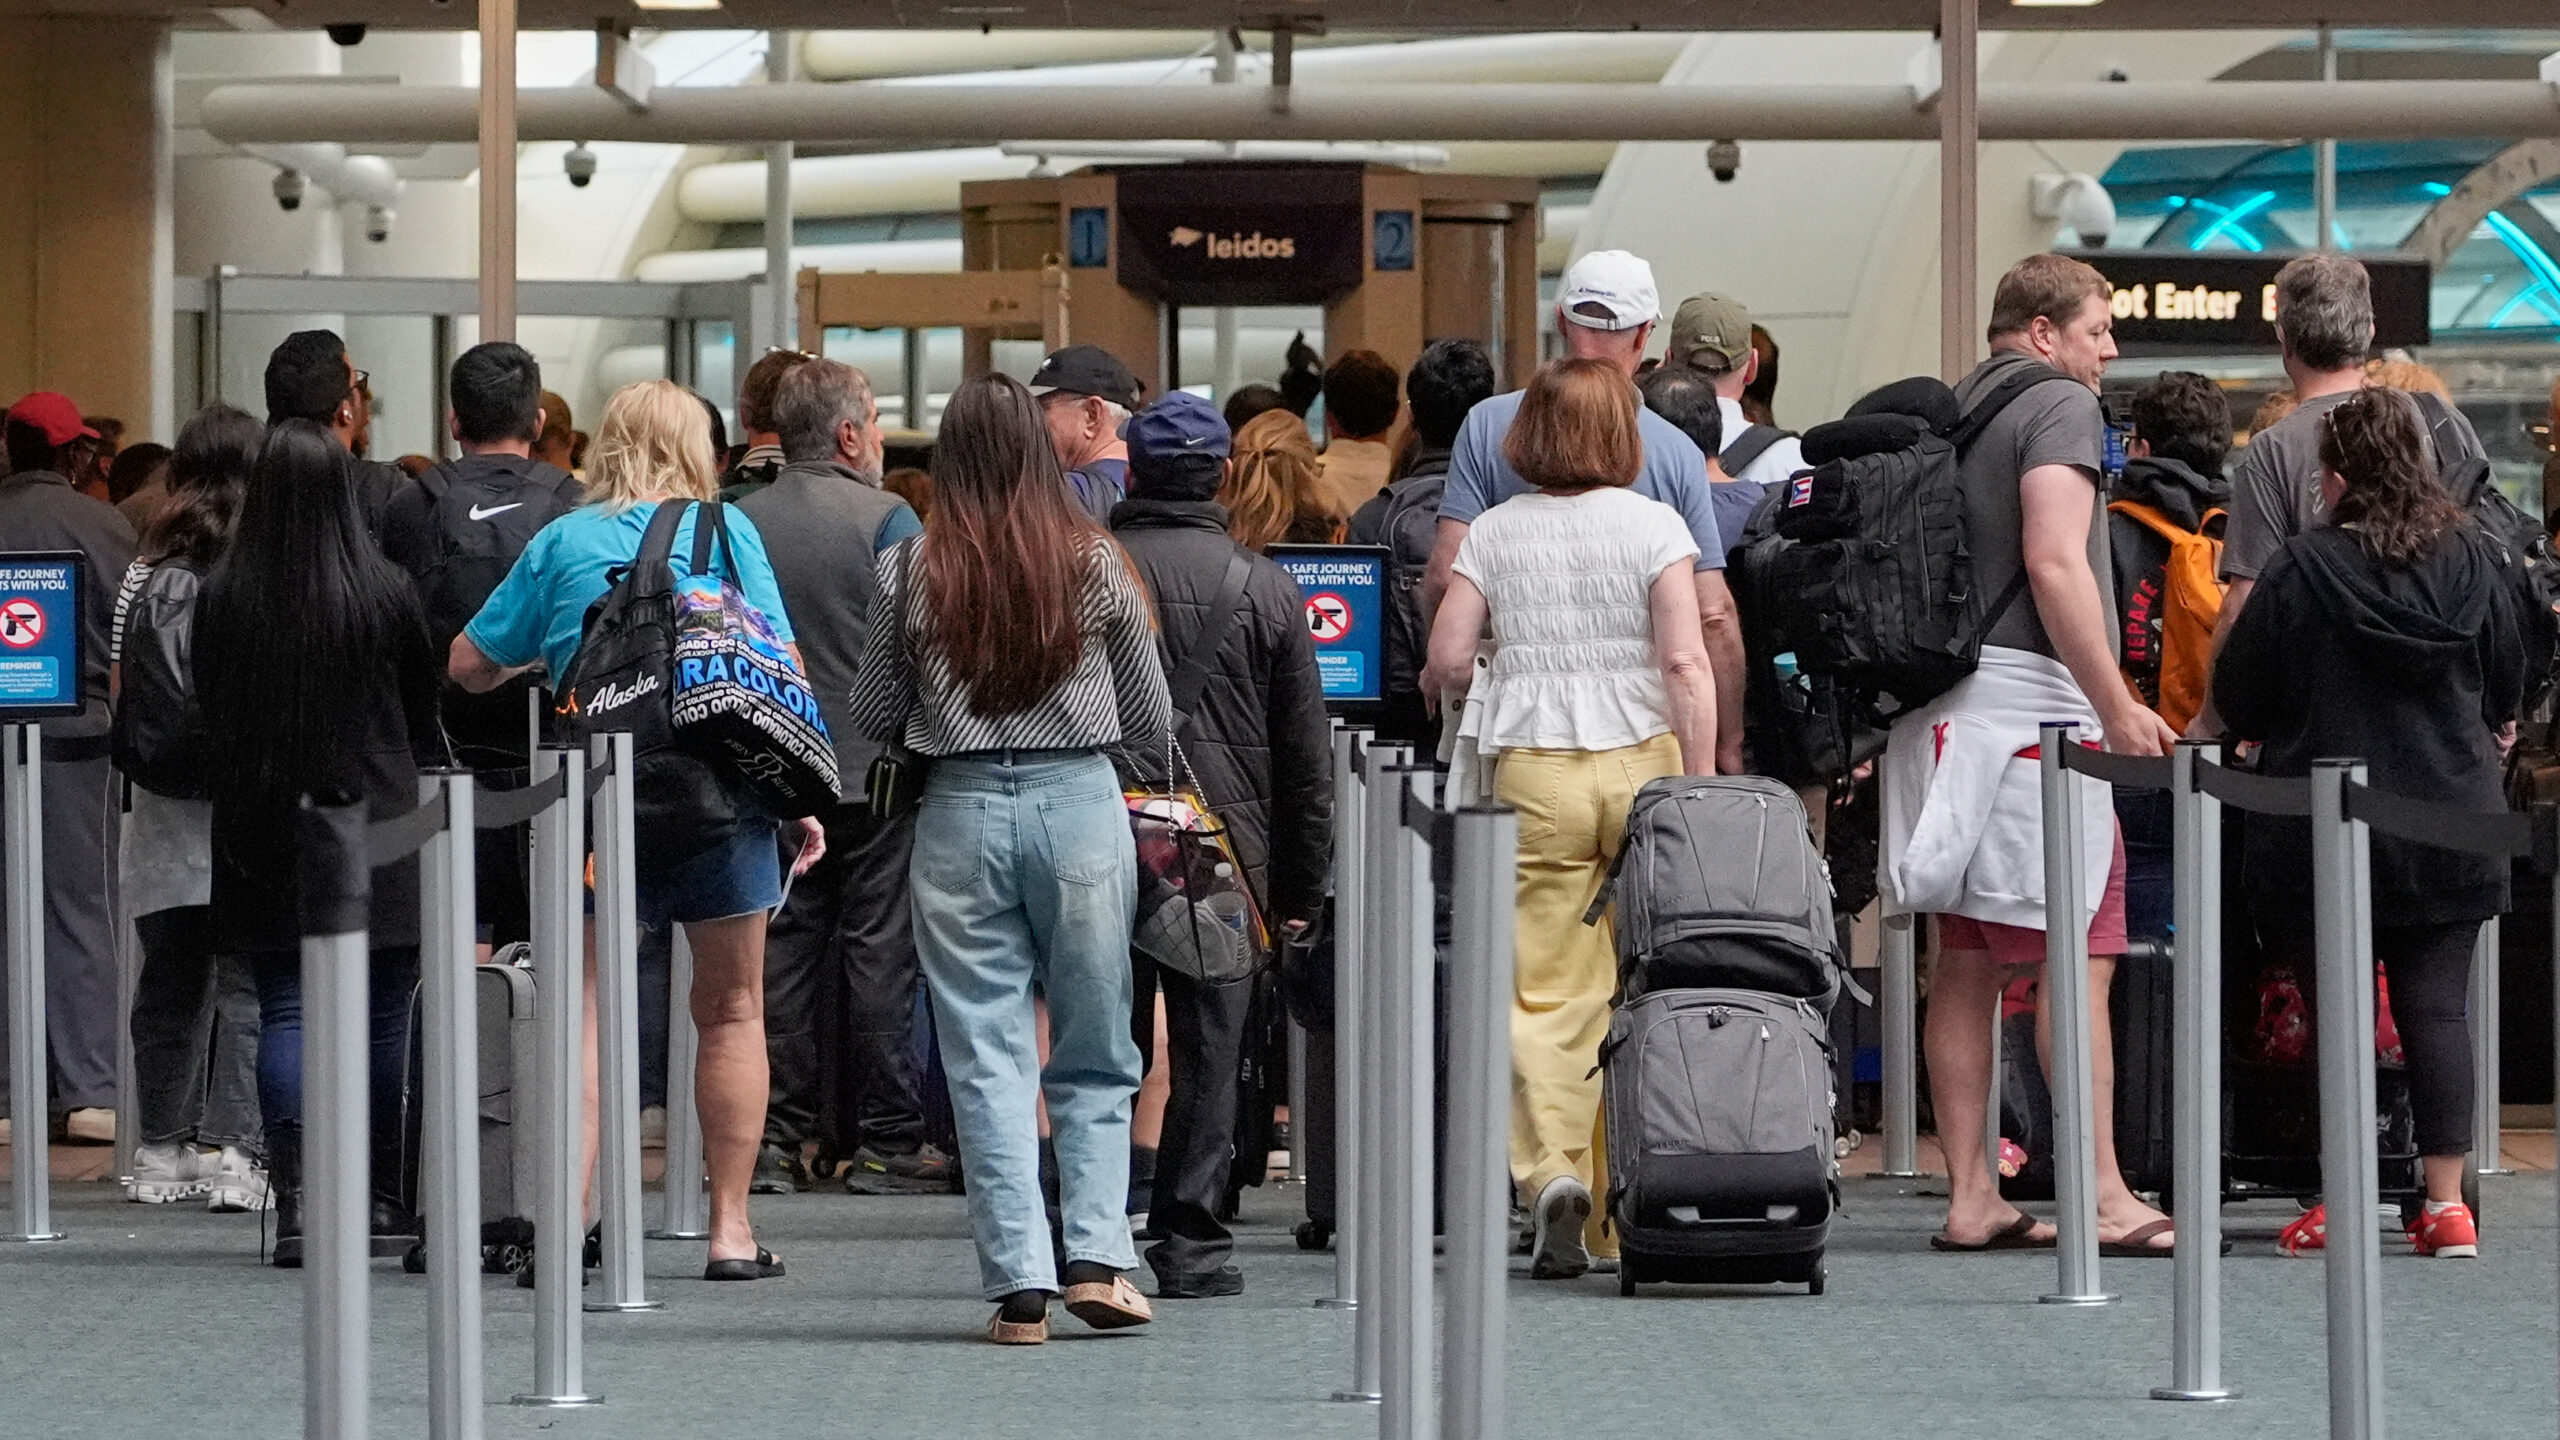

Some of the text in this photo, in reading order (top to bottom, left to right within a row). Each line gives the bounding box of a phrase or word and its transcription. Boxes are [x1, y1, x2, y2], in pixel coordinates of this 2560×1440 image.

[1207, 232, 1295, 259] leidos
[2106, 281, 2148, 319] ot
[2155, 282, 2242, 320] Enter
[1700, 335, 1720, 343] POLO
[13, 569, 65, 579] JOURNEY
[1292, 564, 1319, 574] SAFE
[1320, 564, 1372, 574] JOURNEY
[11, 581, 39, 590] WITH
[41, 580, 69, 590] YOU.
[1317, 575, 1347, 585] WITH
[1349, 575, 1375, 585] YOU.
[0, 662, 43, 670] REMINDER
[586, 671, 659, 717] Alaska
[685, 689, 724, 706] COLORADO
[771, 711, 799, 734] COLORADO
[752, 710, 806, 757] COLORADO
